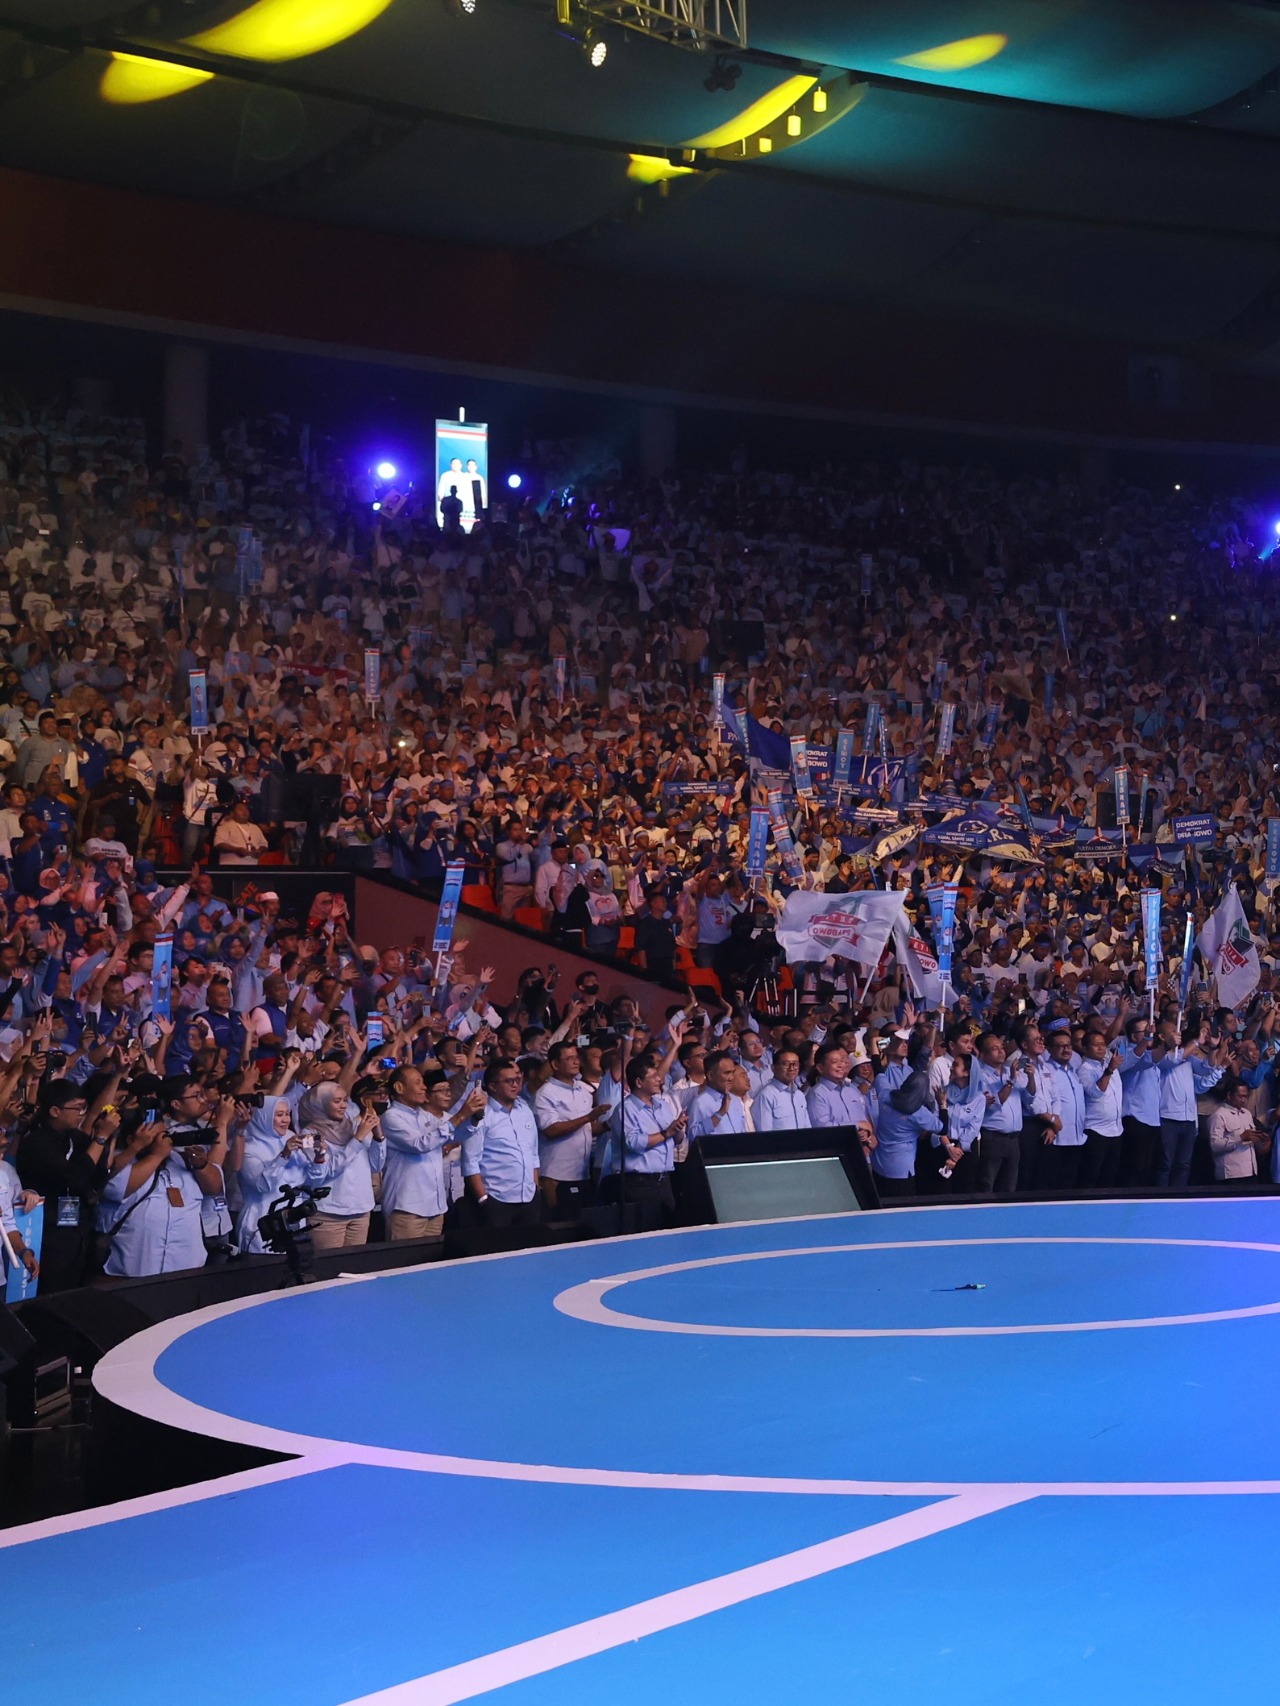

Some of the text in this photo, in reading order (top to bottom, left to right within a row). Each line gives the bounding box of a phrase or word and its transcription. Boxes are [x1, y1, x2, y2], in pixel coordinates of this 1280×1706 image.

[1118, 772, 1126, 816] GIBRAN
[1176, 819, 1210, 829] DEMOKRAT
[913, 941, 929, 952] ETI
